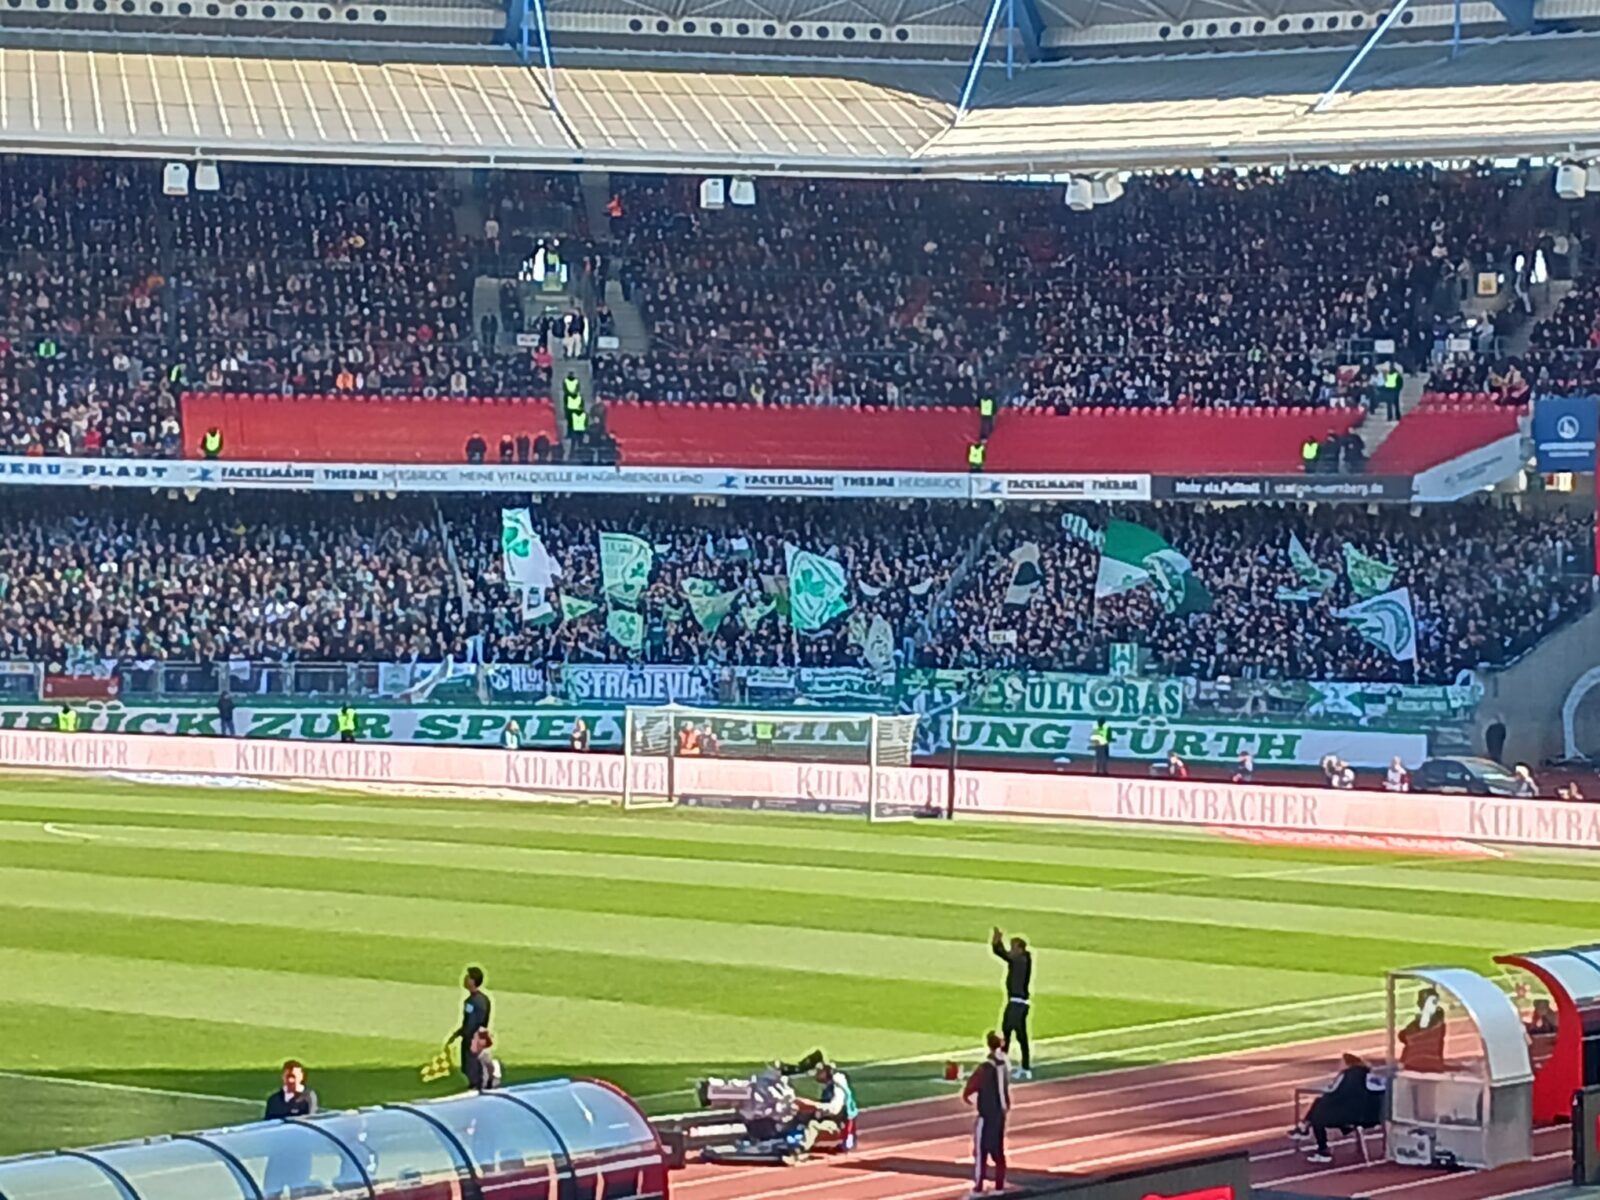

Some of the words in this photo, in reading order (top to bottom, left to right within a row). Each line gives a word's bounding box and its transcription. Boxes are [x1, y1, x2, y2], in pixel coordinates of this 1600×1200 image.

[324, 468, 378, 480] THERME
[843, 475, 895, 488] THERME
[246, 711, 393, 740] ZUR
[235, 744, 392, 777] KULMBACHER
[1116, 782, 1318, 826] KULMBACHER
